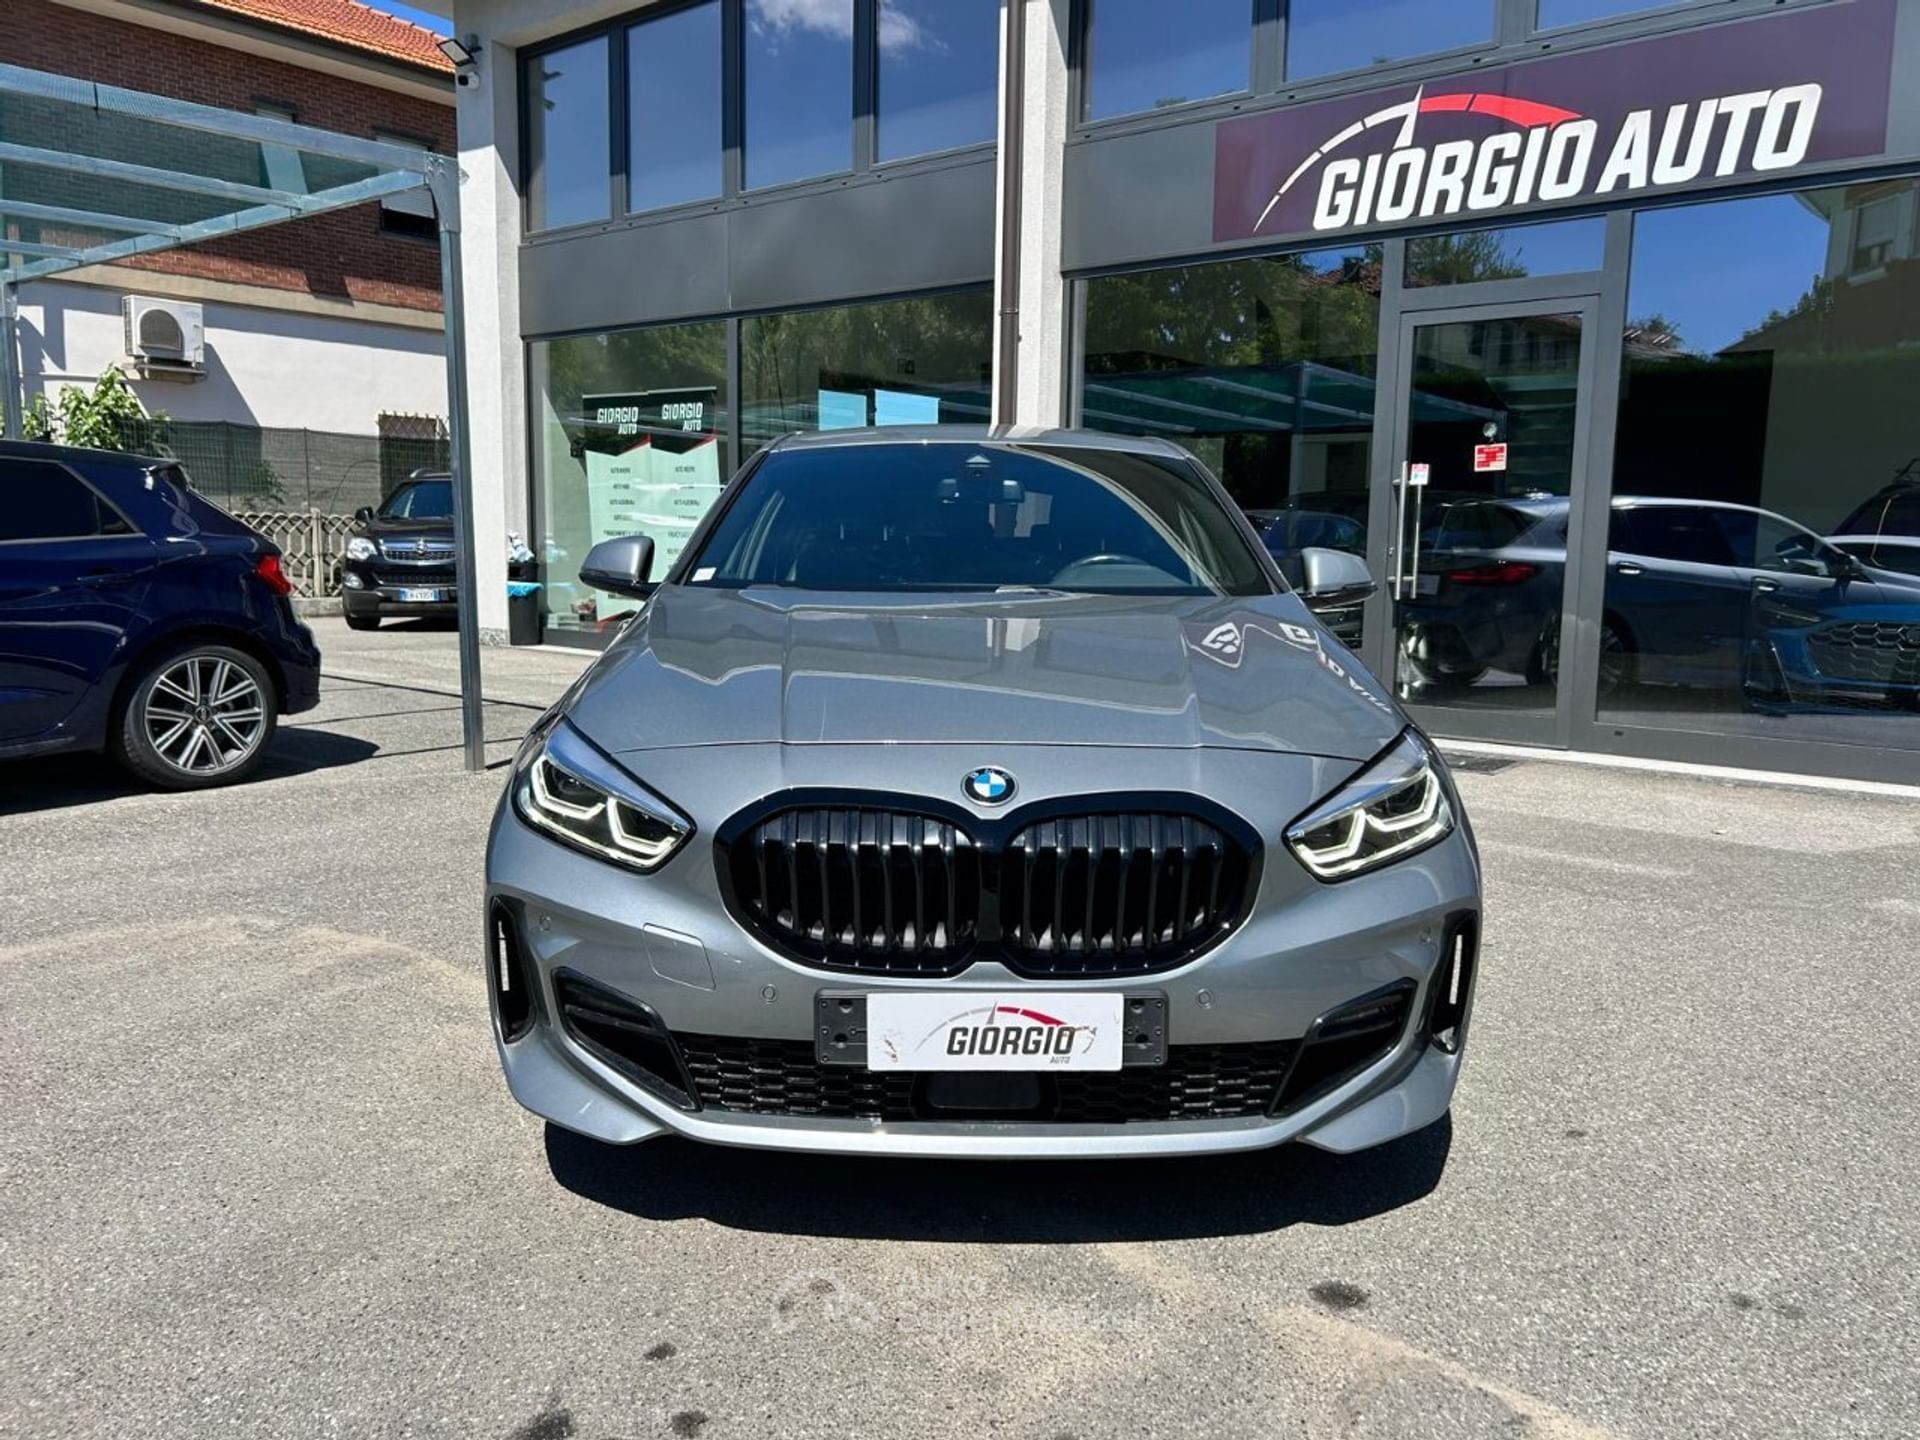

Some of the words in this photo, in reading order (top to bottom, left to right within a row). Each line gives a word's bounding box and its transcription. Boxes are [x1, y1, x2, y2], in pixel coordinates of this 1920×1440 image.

[1313, 118, 1598, 231] GIORGIO
[1595, 83, 1823, 194] AUTO
[597, 406, 639, 424] GIORGIO
[661, 402, 703, 421] GIORGIO
[618, 423, 638, 435] AUTO
[682, 419, 702, 432] AUTO
[946, 1026, 1076, 1055] GIORGIO
[1050, 1056, 1071, 1065] AUTO
